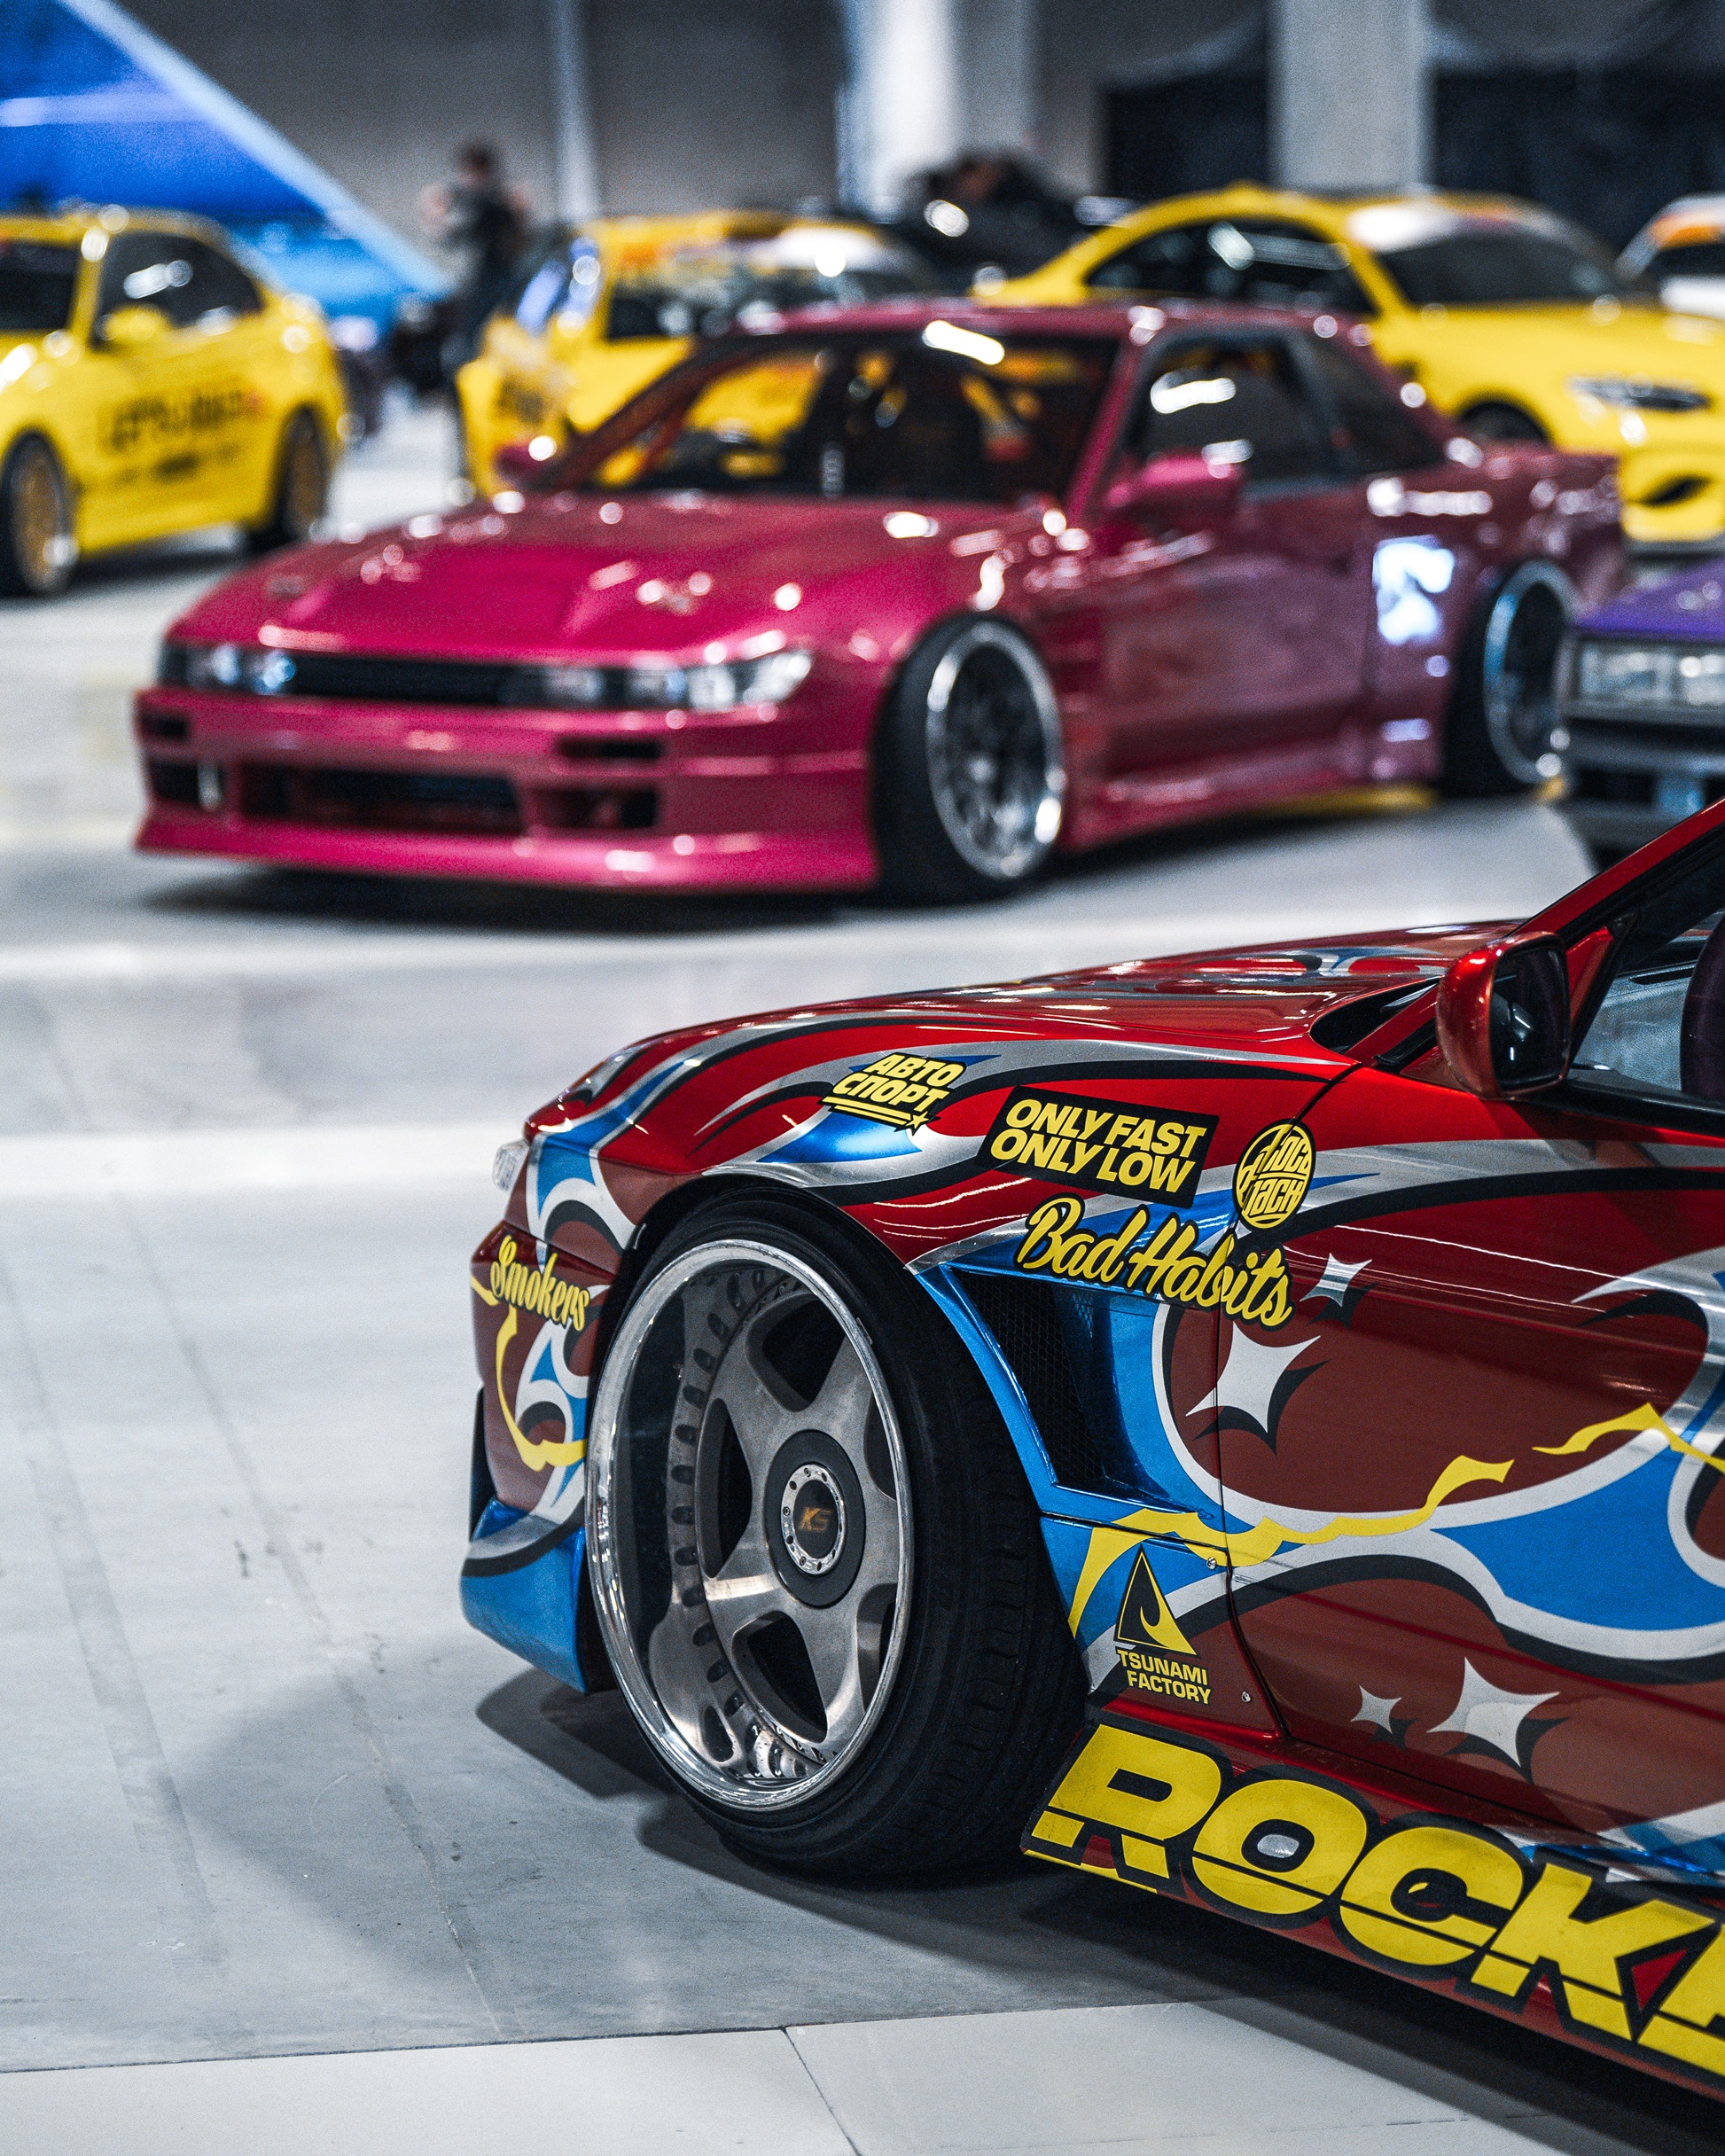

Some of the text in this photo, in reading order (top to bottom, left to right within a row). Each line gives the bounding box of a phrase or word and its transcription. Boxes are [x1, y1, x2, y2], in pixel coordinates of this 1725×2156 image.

[832, 1073, 950, 1112] СПОРТ
[863, 1054, 964, 1087] АВТО
[1005, 1098, 1206, 1158] ONLY FAST
[990, 1129, 1104, 1175] ONLY
[1096, 1148, 1196, 1193] LOW
[490, 1235, 589, 1332] Smokers
[1017, 1197, 1292, 1327] Bad Habits
[1117, 1649, 1208, 1685] TSUNAMI
[1127, 1669, 1212, 1705] FACTORY
